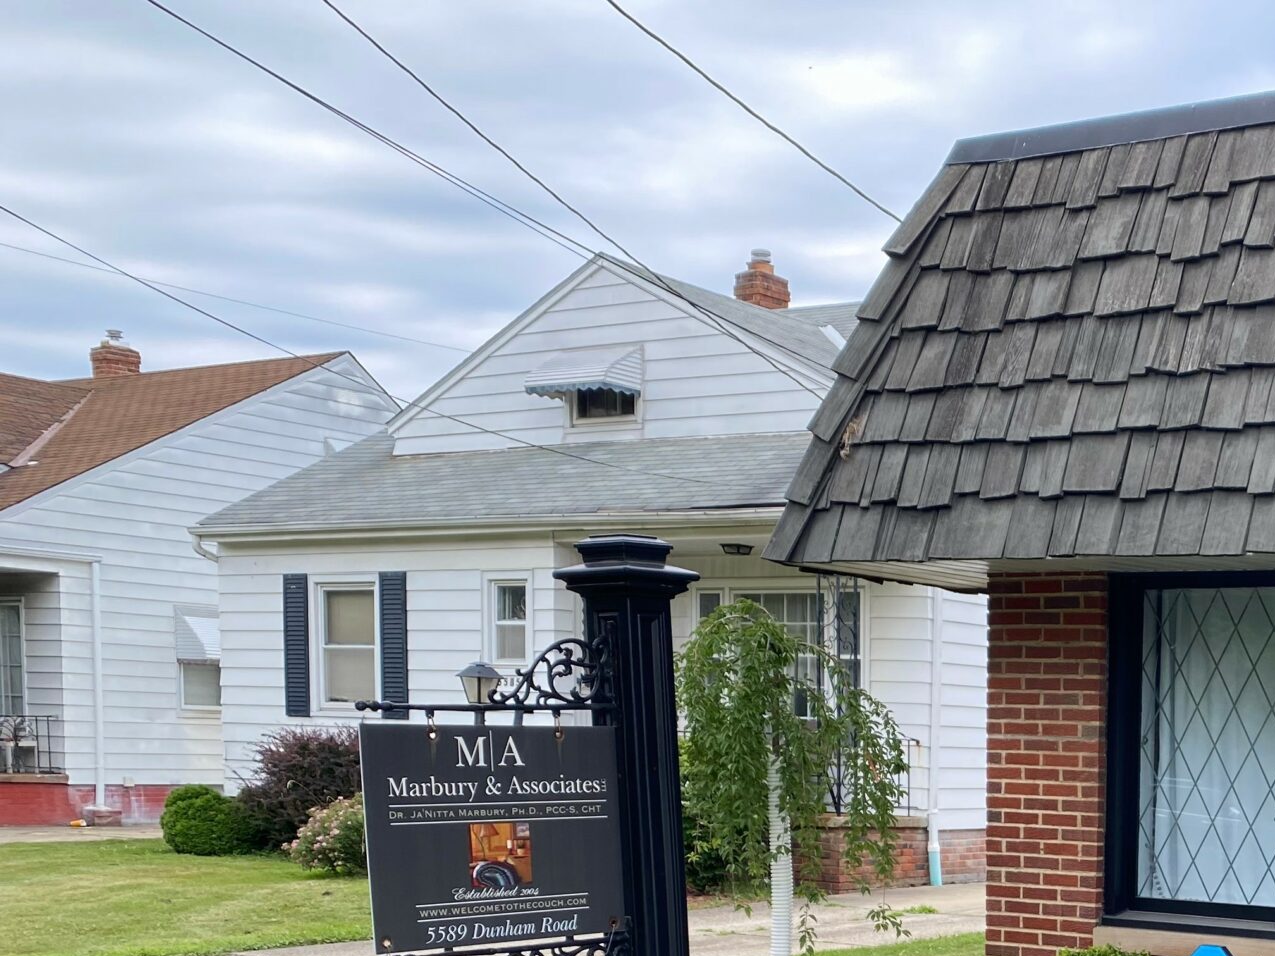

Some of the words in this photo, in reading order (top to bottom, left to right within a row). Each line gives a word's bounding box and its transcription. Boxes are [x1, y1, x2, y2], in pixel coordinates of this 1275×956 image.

[387, 776, 479, 802] Marbury
[485, 775, 501, 795] &
[507, 774, 601, 795] Associates
[581, 804, 602, 814] CHT
[451, 885, 519, 901] Established
[426, 923, 467, 945] 5589
[472, 919, 536, 940] Dunham
[541, 913, 578, 933] Road
